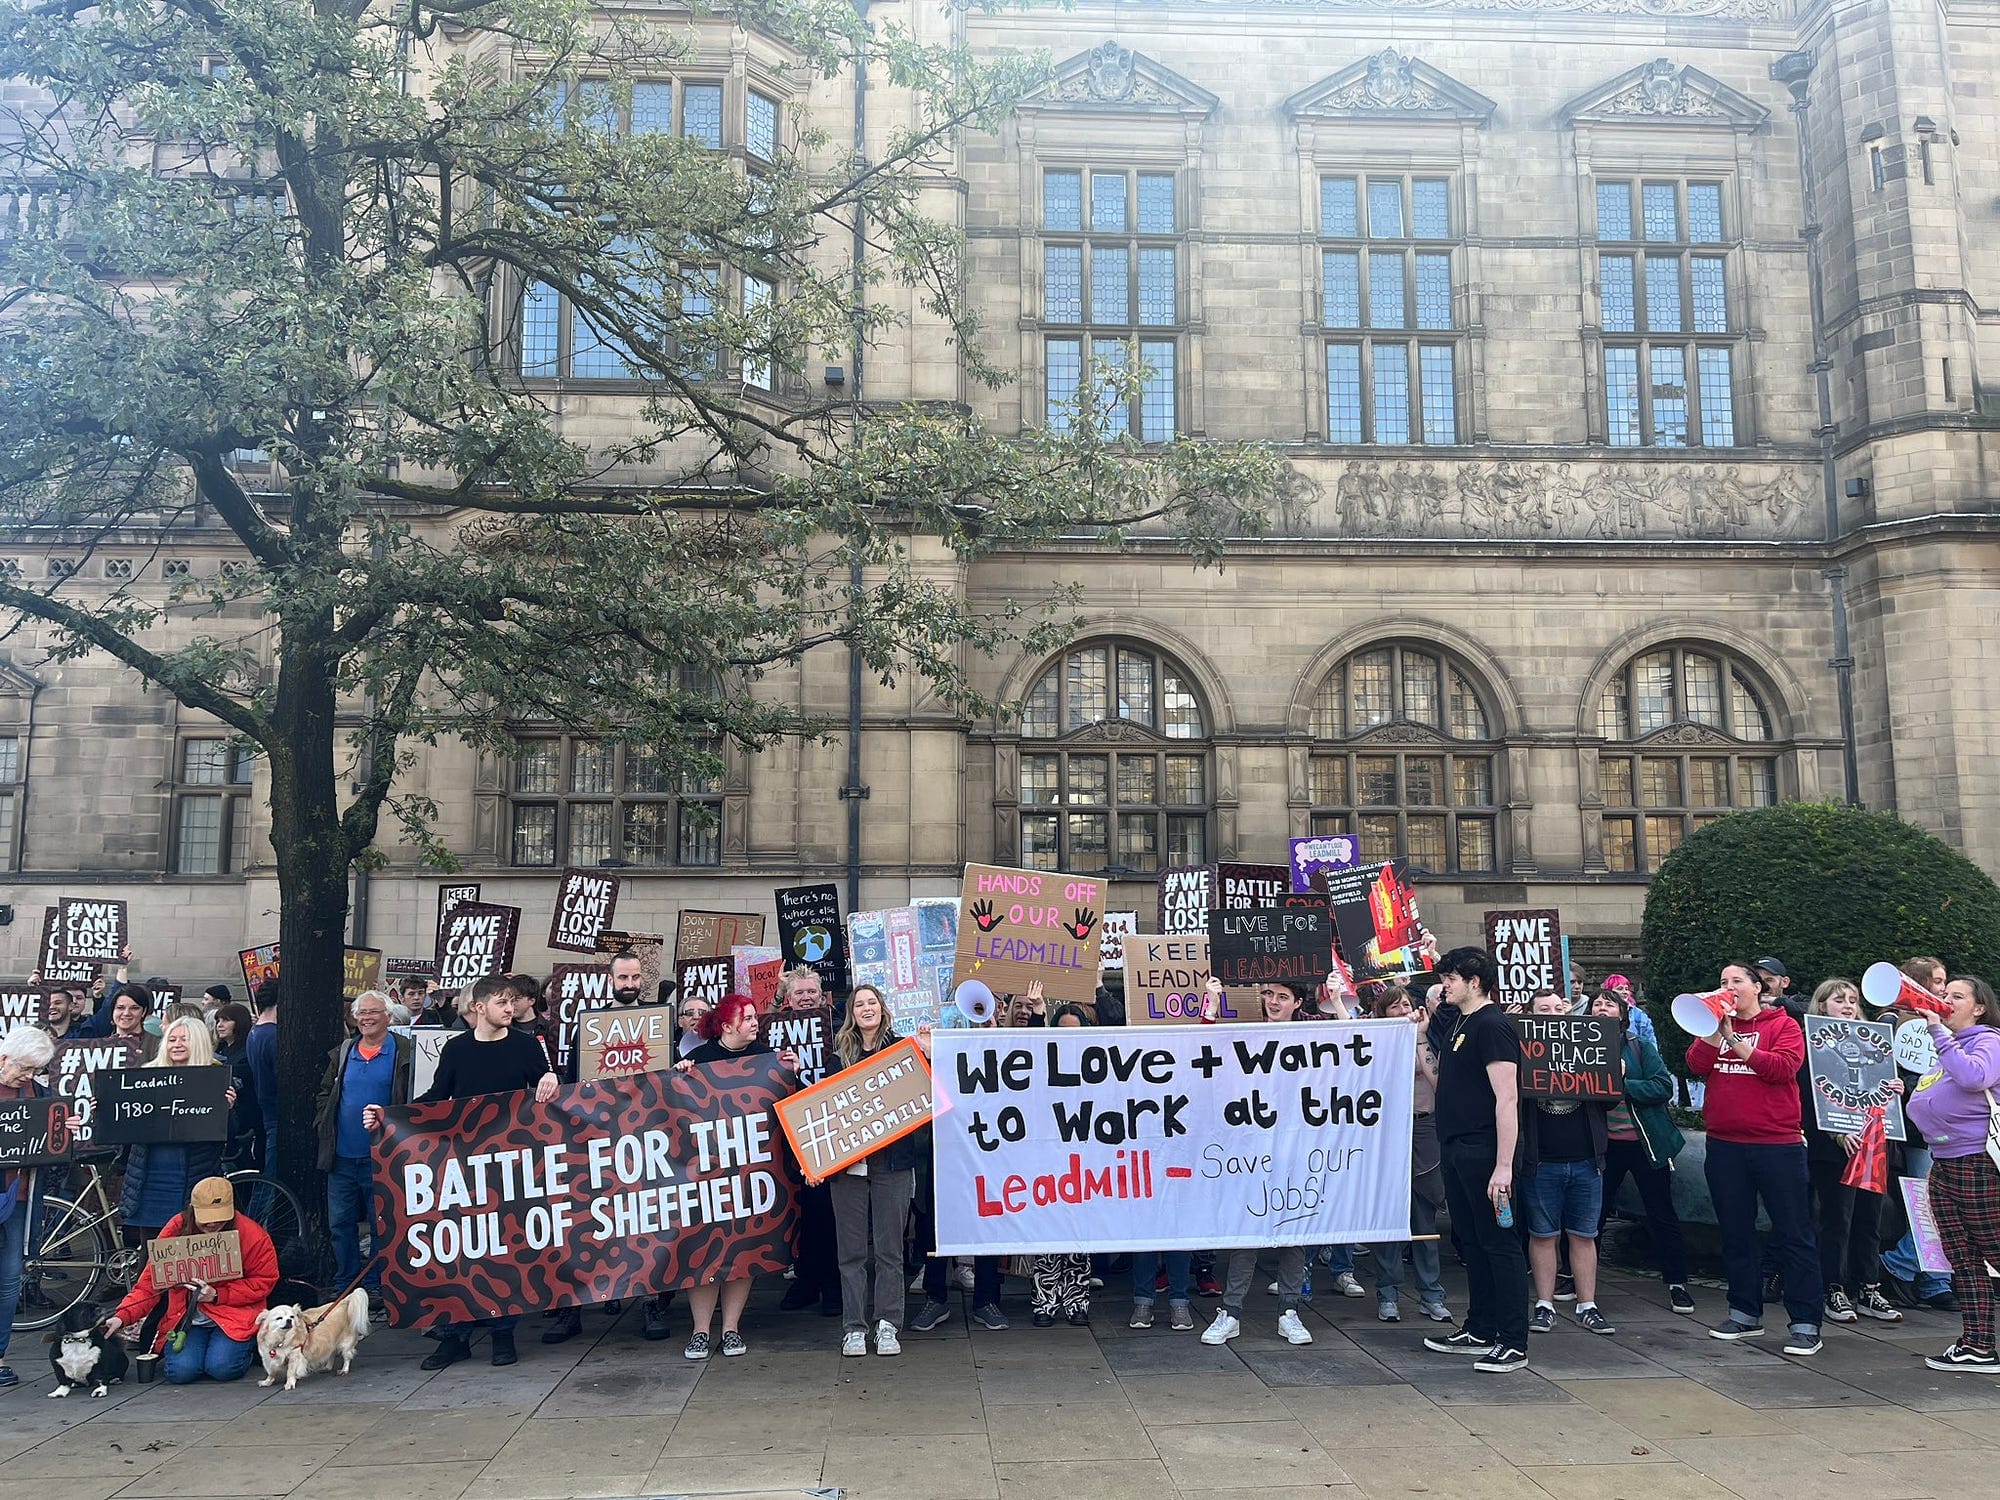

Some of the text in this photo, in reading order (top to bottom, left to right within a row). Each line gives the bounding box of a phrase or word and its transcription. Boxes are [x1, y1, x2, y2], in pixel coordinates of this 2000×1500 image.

[567, 875, 613, 899] #WE
[978, 874, 1097, 903] HANDS OFF
[1165, 871, 1209, 891] #WE
[1330, 881, 1362, 891] SEPTEMBER
[1341, 874, 1365, 883] MONDAY
[448, 889, 476, 900] KEEP
[781, 891, 819, 906] There's
[1165, 890, 1209, 909] CANT
[1226, 896, 1251, 909] FOR
[1258, 898, 1277, 909] TH
[1332, 890, 1361, 900] SHEFFIELD
[1351, 895, 1367, 903] HALL
[67, 903, 118, 919] #WE
[563, 894, 609, 918] CANT
[819, 906, 836, 914] else
[1008, 904, 1060, 929] OUR
[66, 916, 119, 933] CANT
[449, 915, 501, 937] #WE
[558, 911, 605, 937] LOSE
[811, 917, 835, 925] earth
[1165, 908, 1208, 929] LOSE
[1223, 914, 1318, 934] LIVE FOR
[67, 931, 119, 949] LOSE
[556, 932, 596, 948] LEADMIL
[681, 936, 705, 944] OFF
[682, 928, 712, 937] TURN
[744, 920, 760, 945] SAV
[1494, 917, 1550, 943] #WE
[66, 947, 119, 959] LEADMILL
[446, 935, 498, 955] CANT
[680, 944, 699, 952] THE
[975, 936, 1083, 969] LEADMILL
[1250, 935, 1288, 953] THE
[1495, 942, 1551, 965] CANT
[44, 970, 92, 982] LEADMILL
[441, 954, 494, 977] LOSE
[684, 963, 727, 987] #WE
[1223, 953, 1326, 981] LEADMILL
[1498, 964, 1554, 990] LOSE
[1500, 990, 1533, 1005] LEAD
[585, 1015, 663, 1046] SAVE
[768, 1017, 823, 1047] #WE
[1518, 1019, 1602, 1043] THERE'S
[1810, 1023, 1893, 1056] SAVE OUR
[1900, 1033, 1923, 1048] SAD
[60, 1047, 127, 1073] #WE
[605, 1049, 643, 1068] OUR
[956, 1034, 1374, 1094] We Love + Want
[1552, 1042, 1607, 1065] PLACE
[1899, 1048, 1923, 1065] LIFE
[863, 1056, 914, 1092] CANT
[1549, 1061, 1575, 1073] LIKE
[1520, 1069, 1622, 1095] LEADMILL
[114, 1101, 154, 1122] 1980
[838, 1096, 886, 1129] LOSE
[968, 1085, 1383, 1153] to Work at the
[837, 1093, 933, 1154] LEADMILL
[404, 1112, 773, 1216] BATTLE FOR THE
[1201, 1143, 1274, 1179] Save
[407, 1171, 777, 1268] SOUL OF SHEFFIELD
[185, 1233, 232, 1256] laugh
[151, 1252, 240, 1287] LEADMILL
